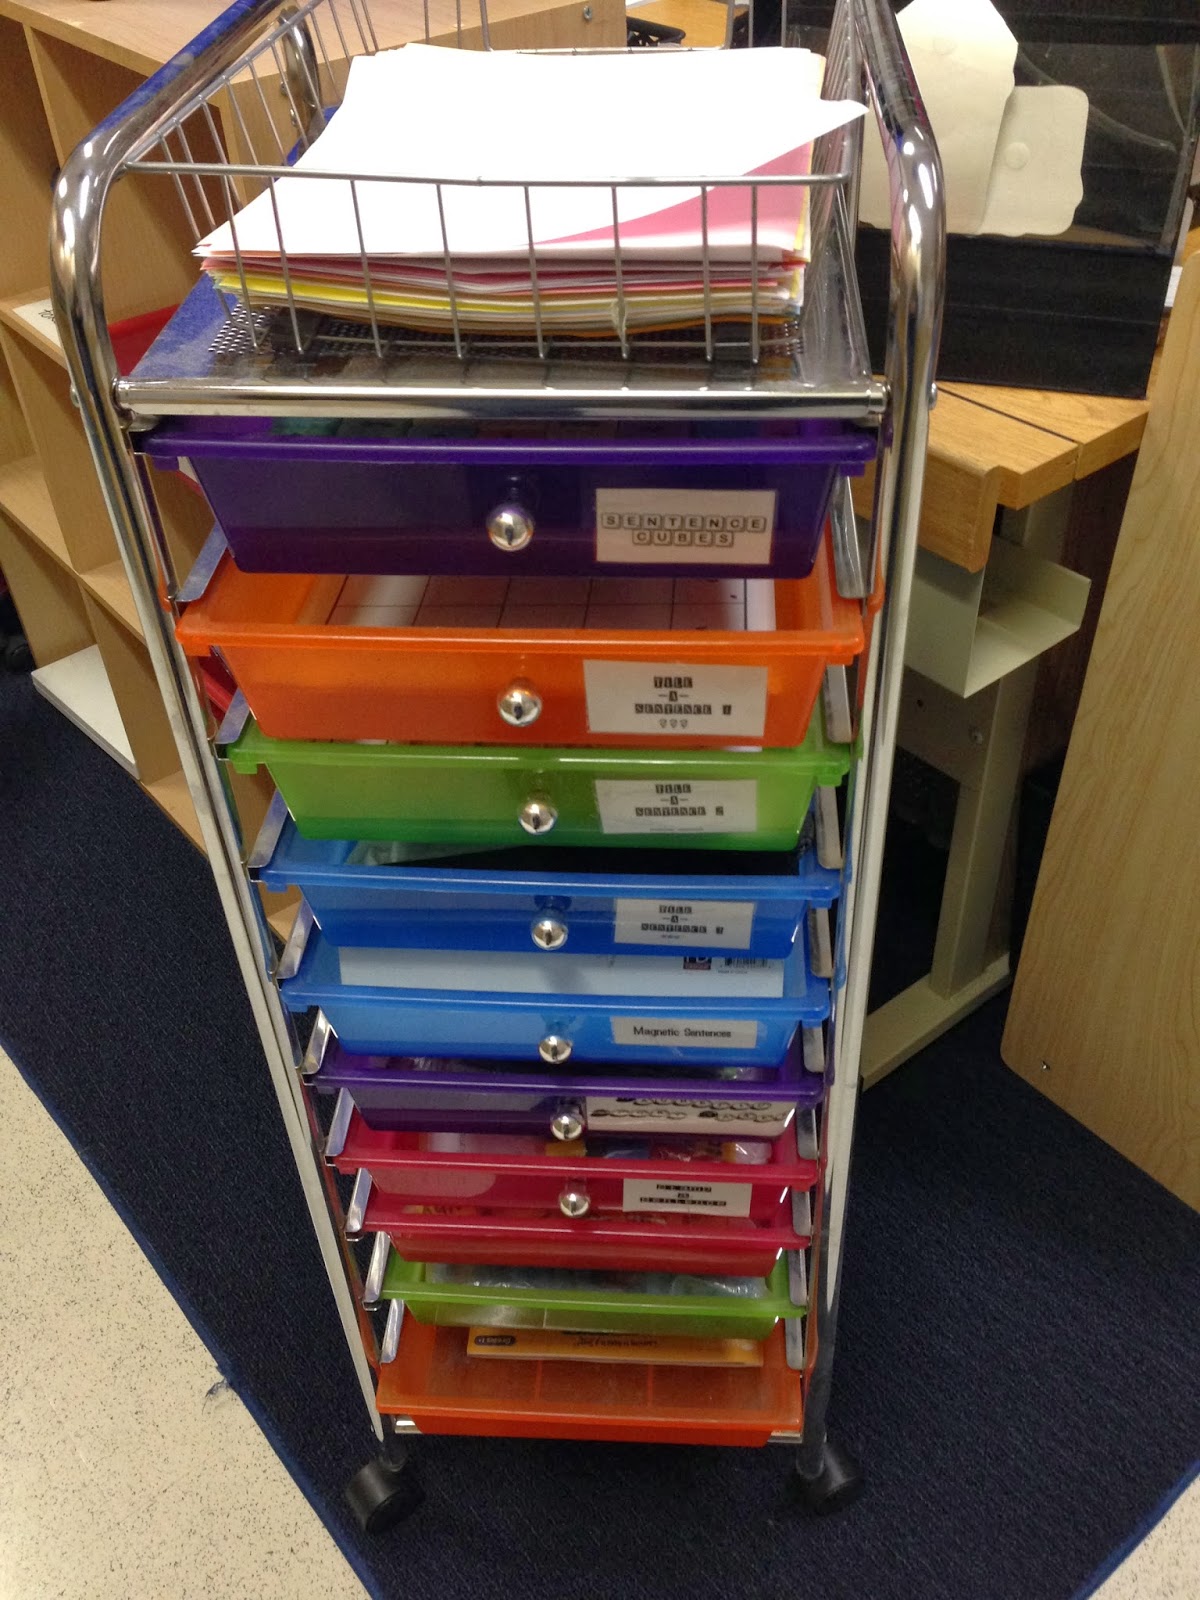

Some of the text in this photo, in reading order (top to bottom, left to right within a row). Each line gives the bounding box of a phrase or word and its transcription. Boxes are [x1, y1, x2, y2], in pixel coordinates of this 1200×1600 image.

[603, 513, 766, 531] SENTENCE
[634, 531, 732, 546] CUBES
[634, 703, 712, 715] SENTENCE
[635, 806, 707, 817] SENTENCE
[641, 923, 707, 934] SENTENCE
[633, 1025, 732, 1038] Magnetic Sentences
